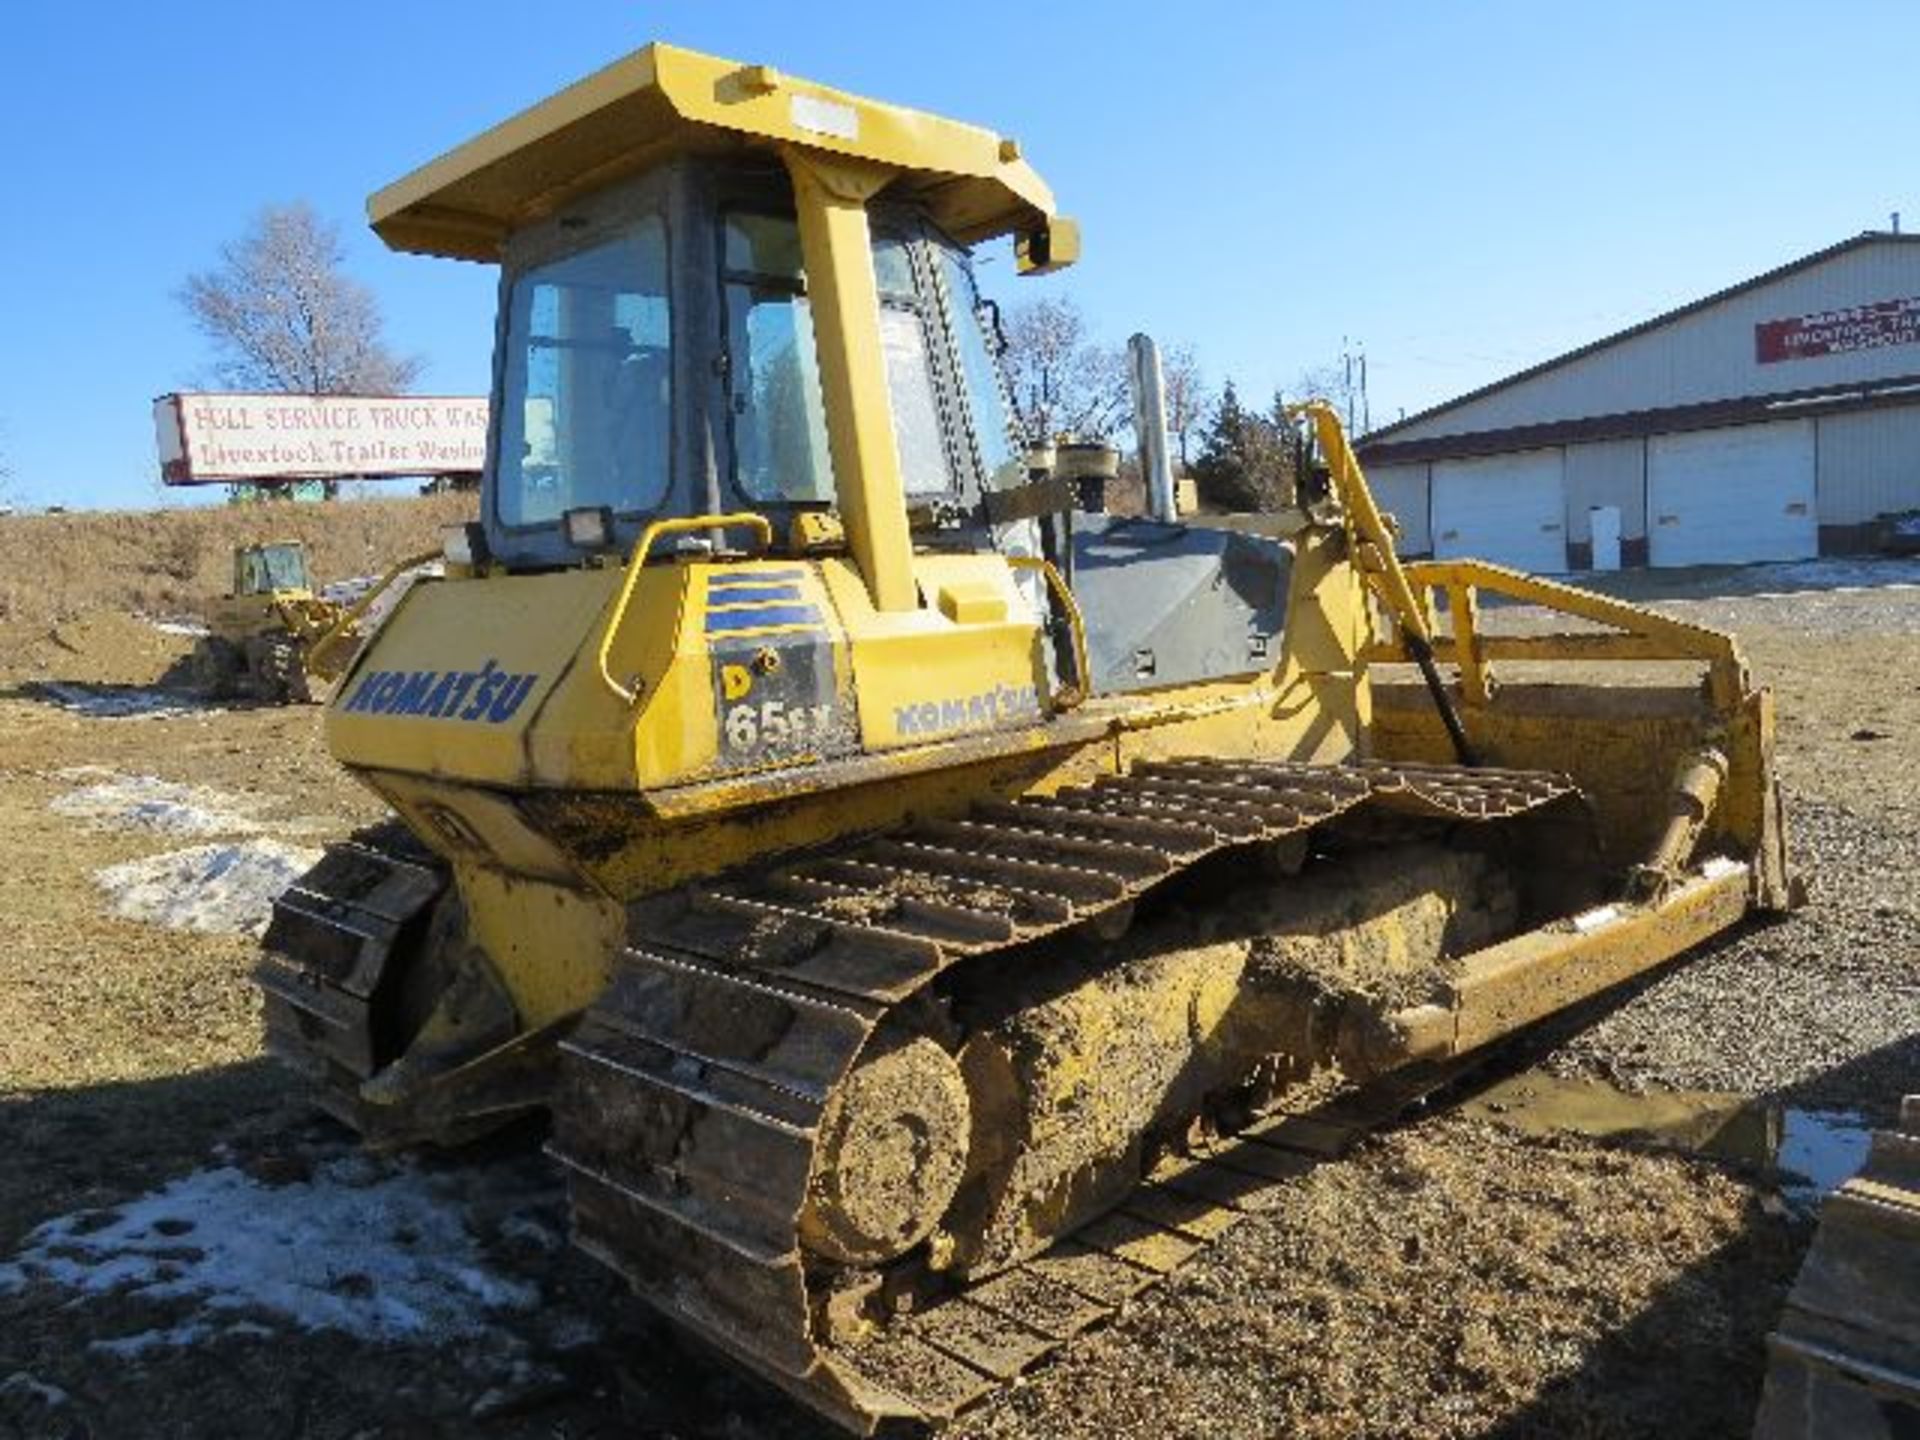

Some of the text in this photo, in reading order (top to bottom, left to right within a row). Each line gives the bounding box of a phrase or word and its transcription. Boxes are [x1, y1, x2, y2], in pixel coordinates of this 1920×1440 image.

[194, 406, 489, 430] FULL SERVICE TRUCK WAS
[201, 441, 323, 466] Livestock
[330, 440, 408, 462] Trailer
[343, 659, 539, 723] KOMATSU
[723, 665, 751, 700] D
[895, 683, 1039, 735] KOMATSU
